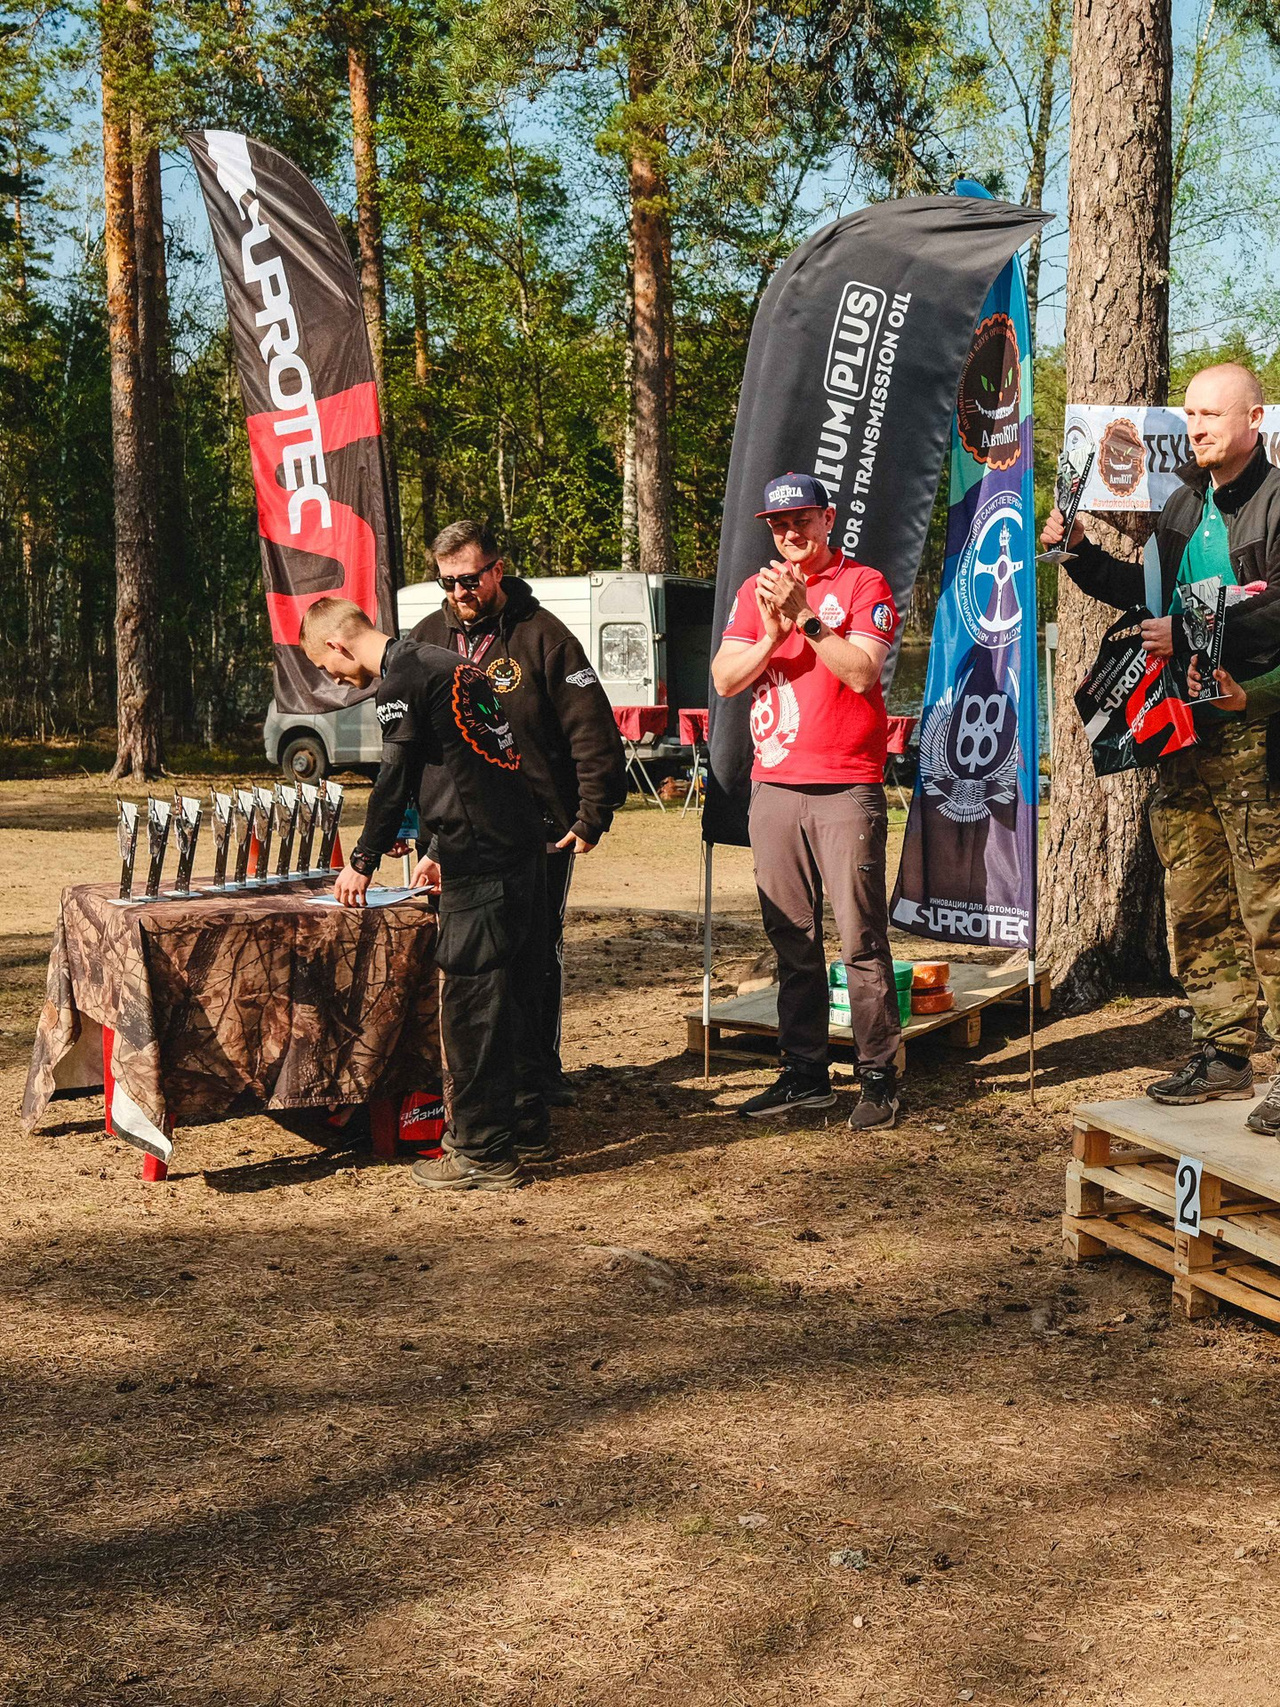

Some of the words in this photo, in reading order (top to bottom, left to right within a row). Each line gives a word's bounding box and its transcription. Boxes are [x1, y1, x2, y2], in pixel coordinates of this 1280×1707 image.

[830, 291, 878, 392] PLUS
[841, 516, 864, 557] TOR
[853, 331, 900, 495] TRANSMISSION
[887, 292, 912, 328] OIL
[981, 423, 1019, 448] АвтоКОТ
[768, 486, 804, 503] SIBERIA
[1103, 647, 1135, 692] АВТОМОБИЛЯ
[929, 897, 968, 910] ИННОВАЦИИ
[968, 902, 983, 911] ДЛЯ
[1178, 1165, 1198, 1228] 2
